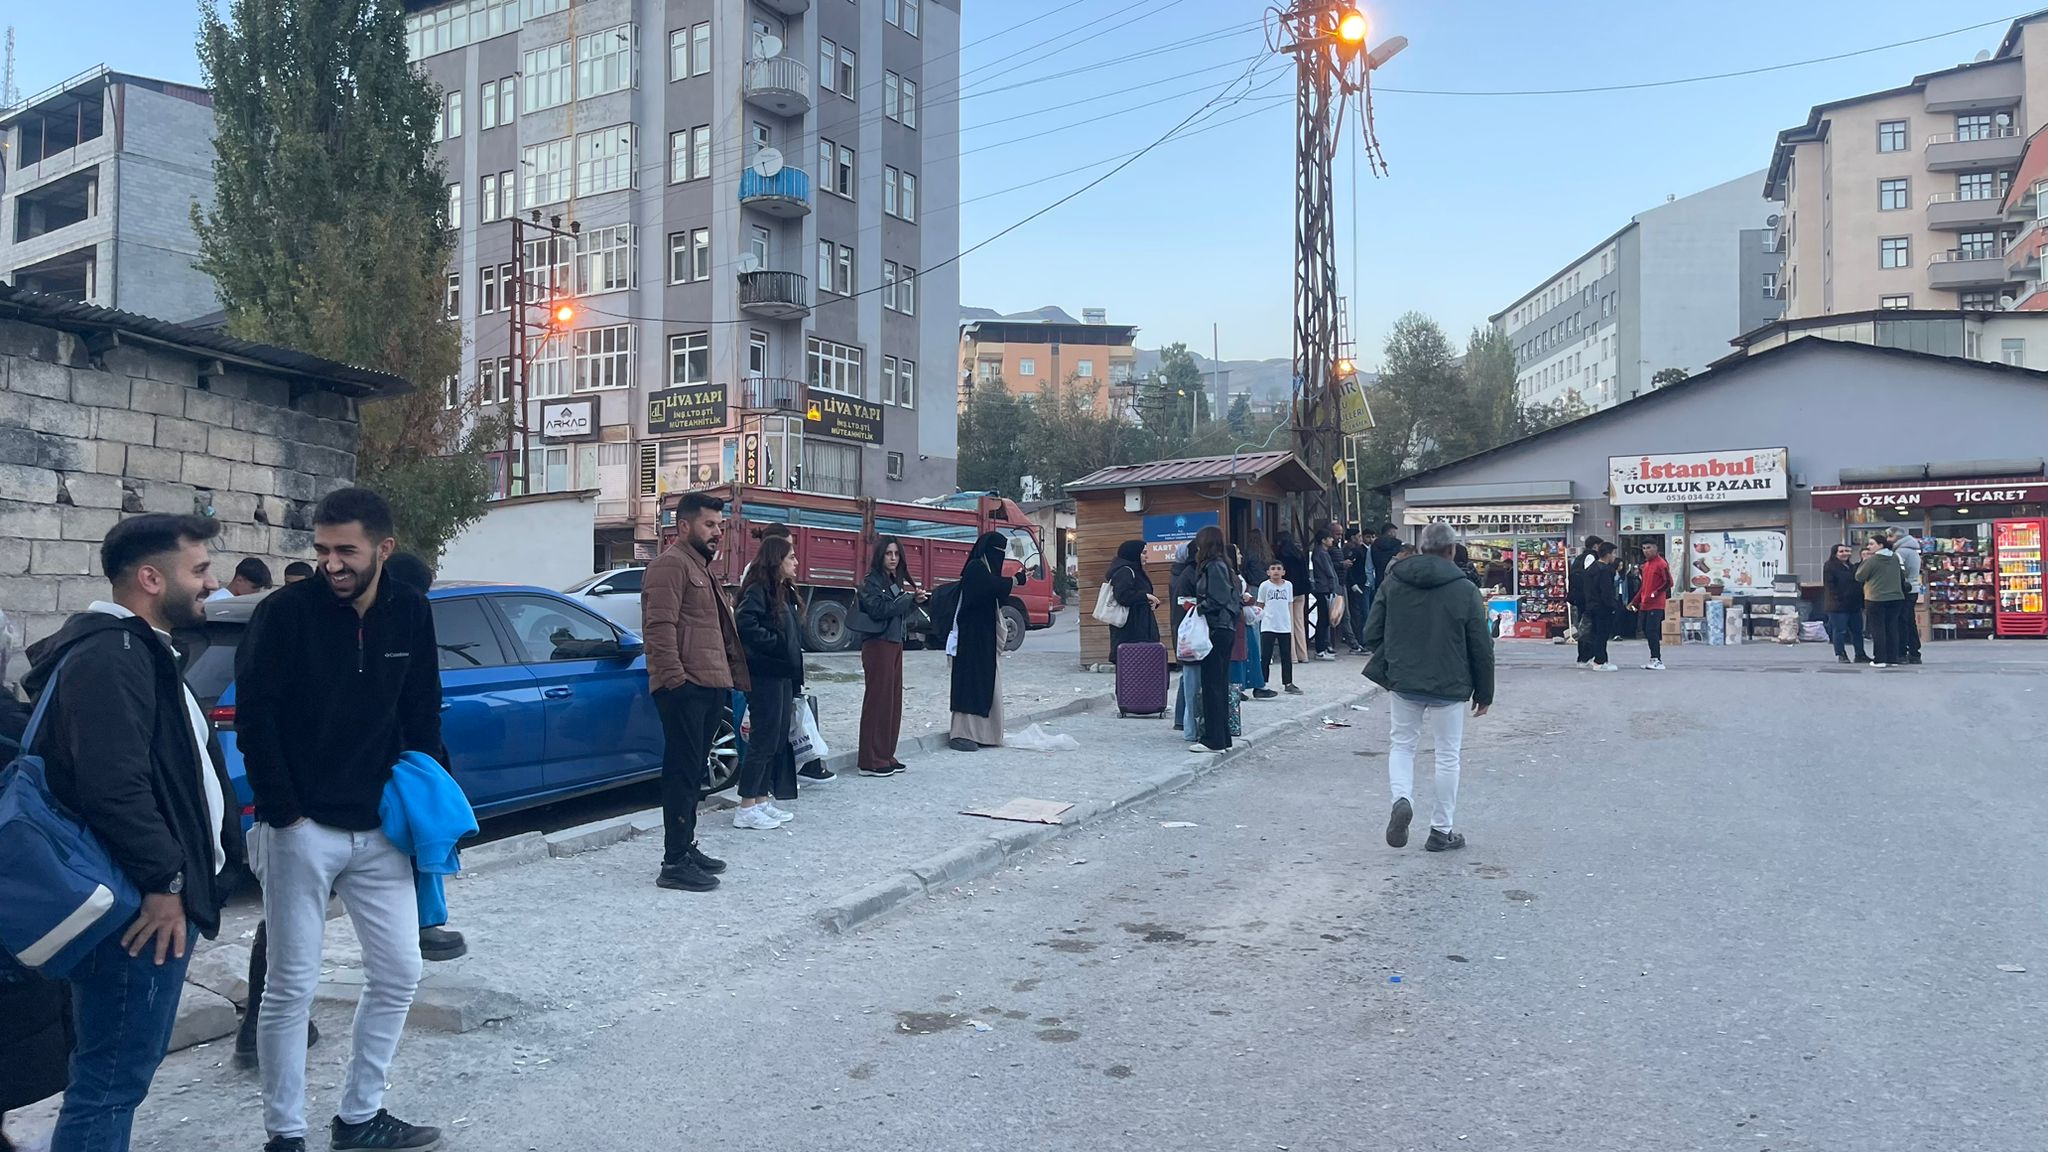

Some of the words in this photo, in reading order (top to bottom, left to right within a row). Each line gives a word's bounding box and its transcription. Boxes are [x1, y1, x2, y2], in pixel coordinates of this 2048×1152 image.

[666, 393, 692, 407] LİVA
[694, 391, 723, 405] YAPI
[824, 397, 852, 416] LİVA
[853, 404, 881, 421] YAPI
[546, 418, 587, 429] ARKAD
[747, 450, 756, 485] KONU
[1640, 456, 1756, 480] İstanbul
[1623, 482, 1702, 495] UCUZLUK
[1706, 478, 1772, 491] PAZARI
[1666, 494, 1686, 502] 0536
[1859, 493, 1921, 506] ÖZKAN
[1953, 490, 2027, 502] TİCARET
[1478, 514, 1544, 524] MARKET
[1152, 544, 1173, 552] KART
